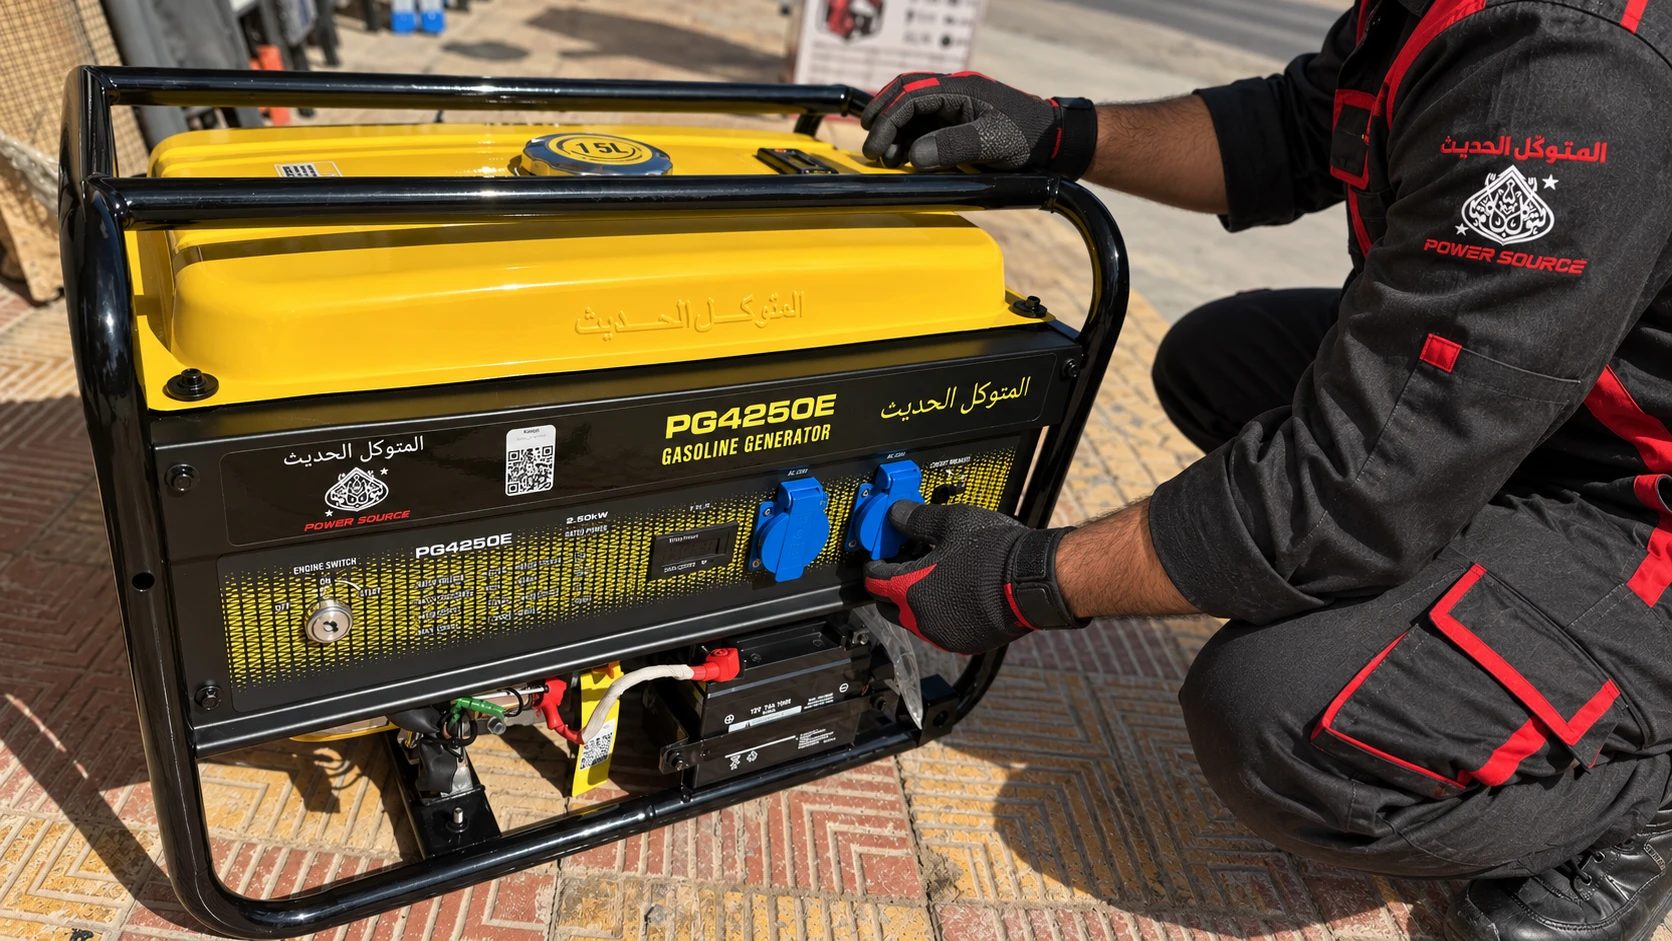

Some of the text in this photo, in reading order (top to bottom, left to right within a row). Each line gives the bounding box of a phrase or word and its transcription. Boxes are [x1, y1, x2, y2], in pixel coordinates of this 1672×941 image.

[1440, 135, 1511, 159] الحديث
[1423, 238, 1589, 275] POWER SOURCE
[575, 290, 804, 342] المتوكل الحديث
[880, 376, 1031, 422] المتوكل الحديث
[665, 393, 837, 440] PG4250E
[283, 435, 424, 467] المتوكل الحديث
[661, 424, 831, 466] GASOLINE GENERATOR
[304, 509, 411, 532] POWER SOURCE
[415, 533, 513, 559] PG4250E
[293, 557, 357, 575] ENGINE SWITCH
